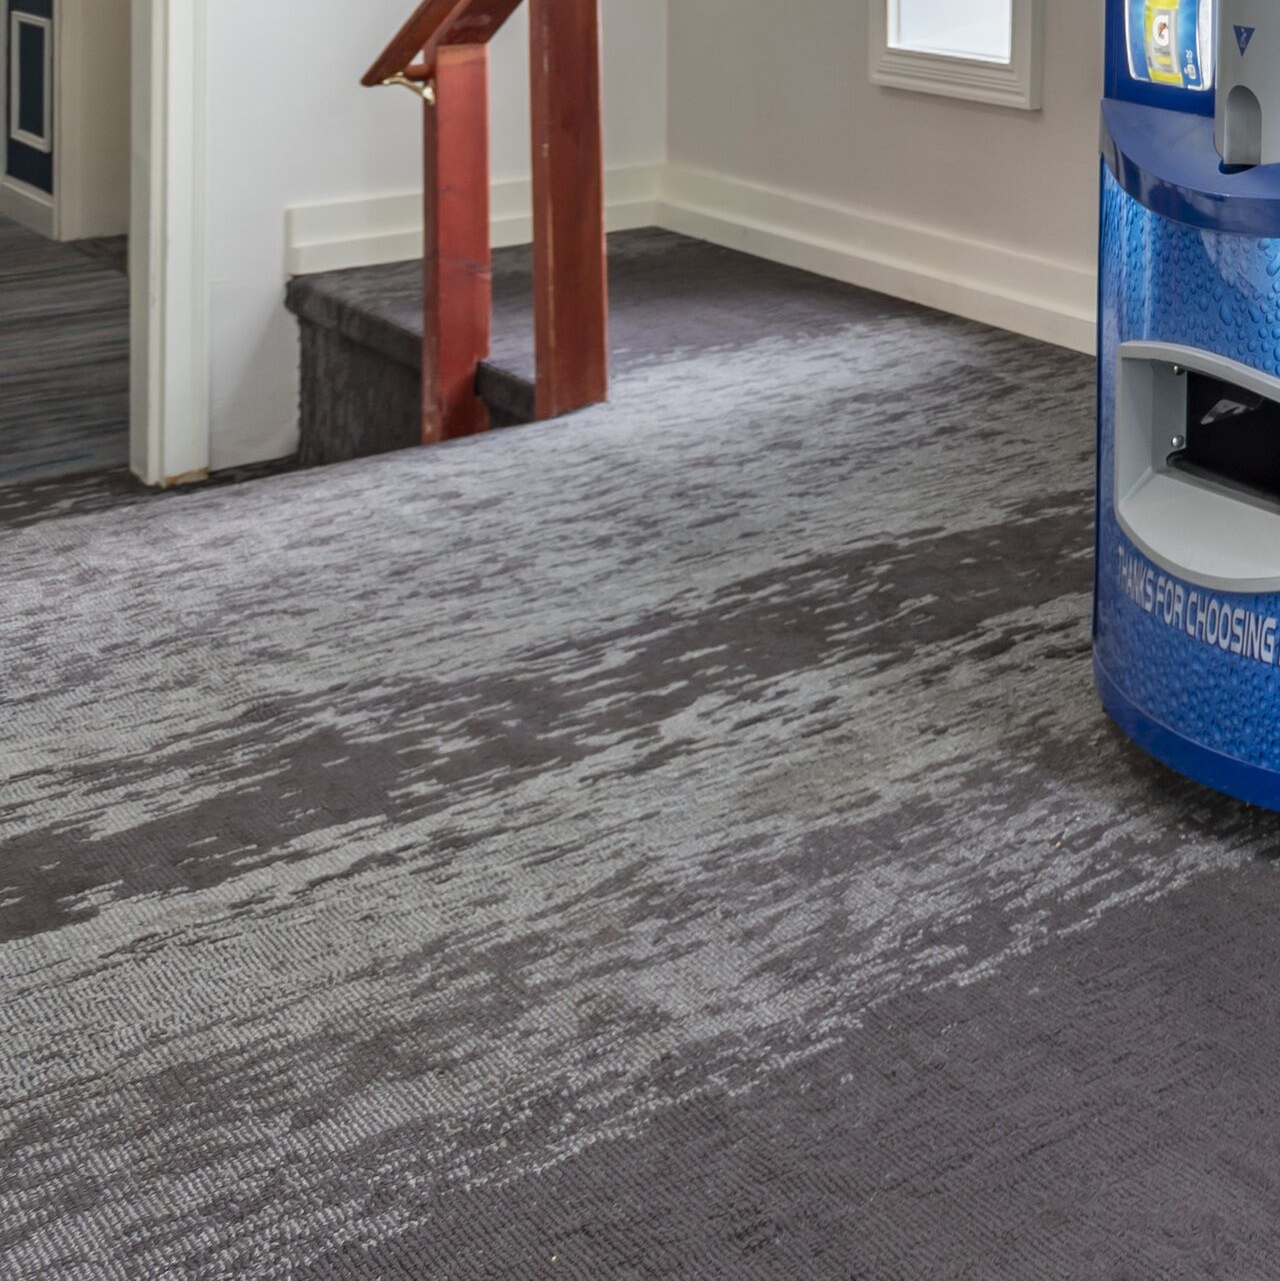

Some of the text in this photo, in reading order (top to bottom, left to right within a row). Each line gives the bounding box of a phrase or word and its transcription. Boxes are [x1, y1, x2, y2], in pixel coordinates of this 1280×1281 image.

[1118, 545, 1154, 612] THANKS
[1155, 576, 1184, 630] FOR
[1185, 591, 1276, 665] CHOOSING
